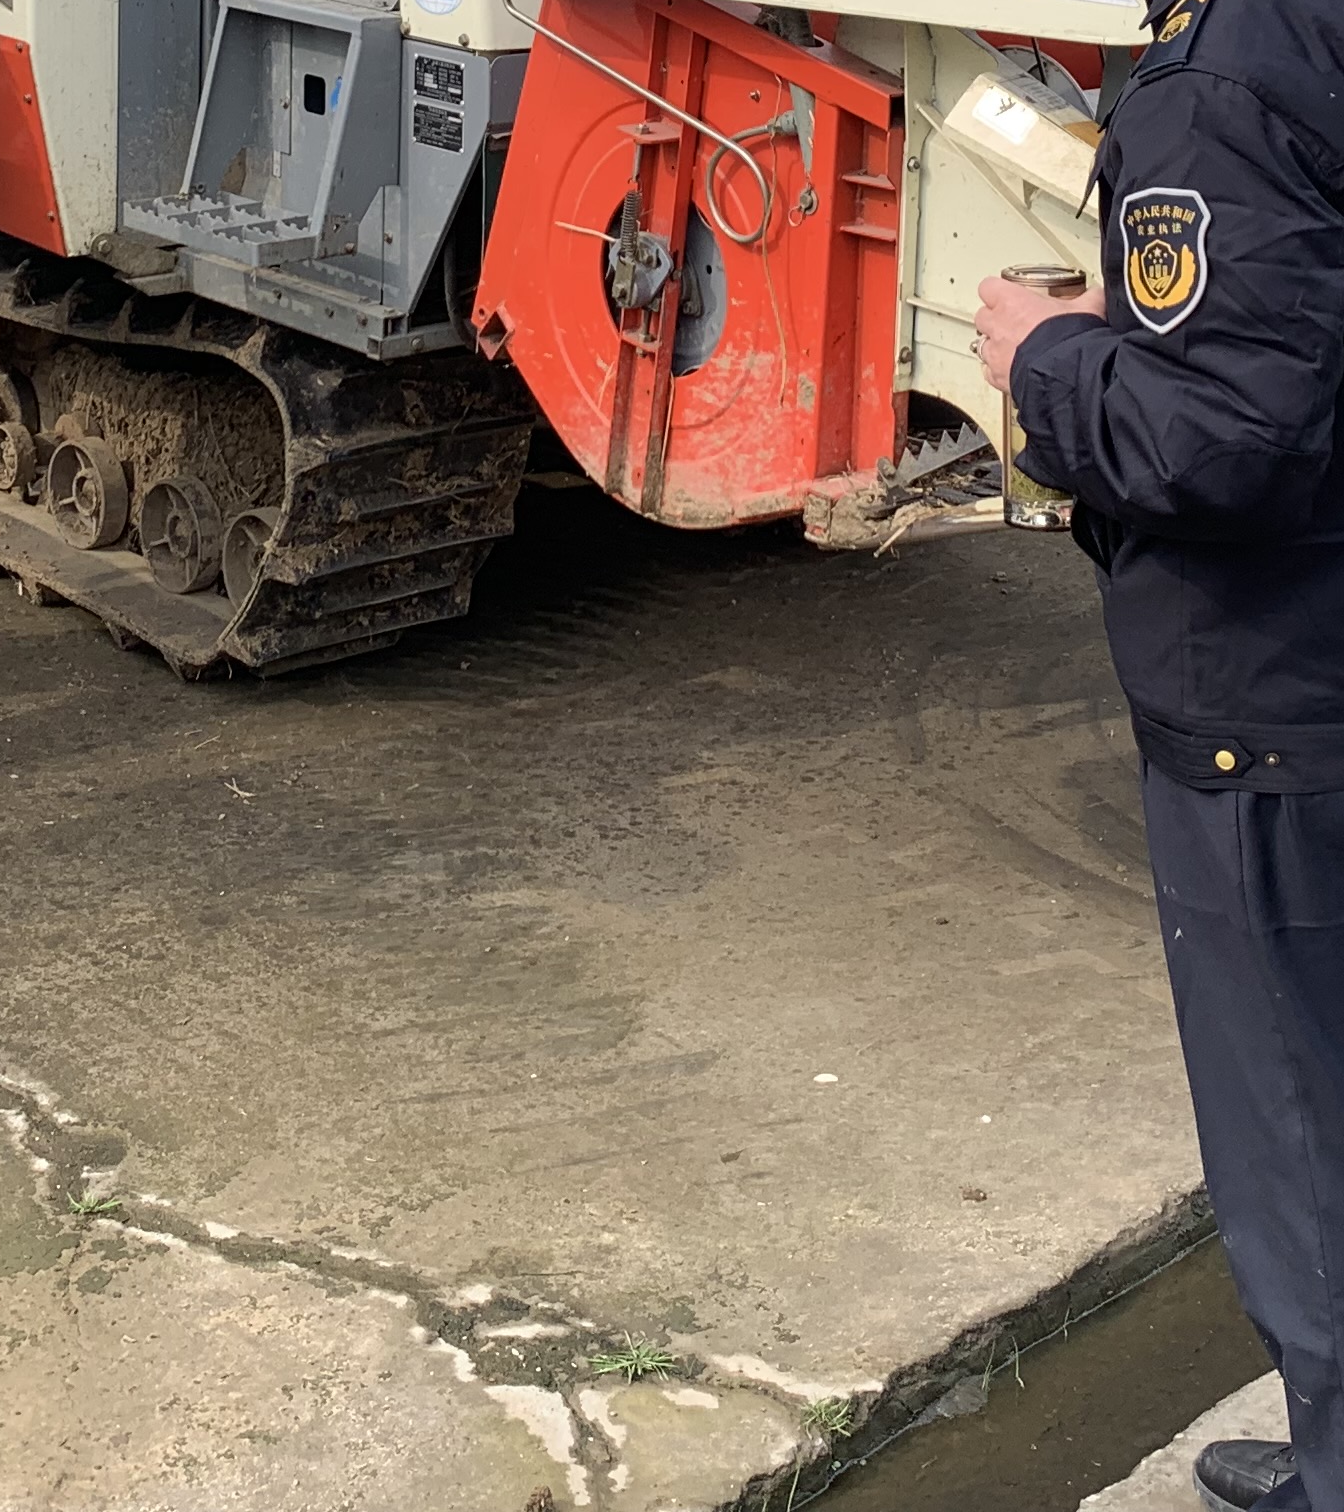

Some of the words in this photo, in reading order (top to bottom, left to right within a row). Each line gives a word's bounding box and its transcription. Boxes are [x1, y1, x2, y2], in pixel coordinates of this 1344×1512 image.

[1127, 204, 1196, 227] 中华人民共和国
